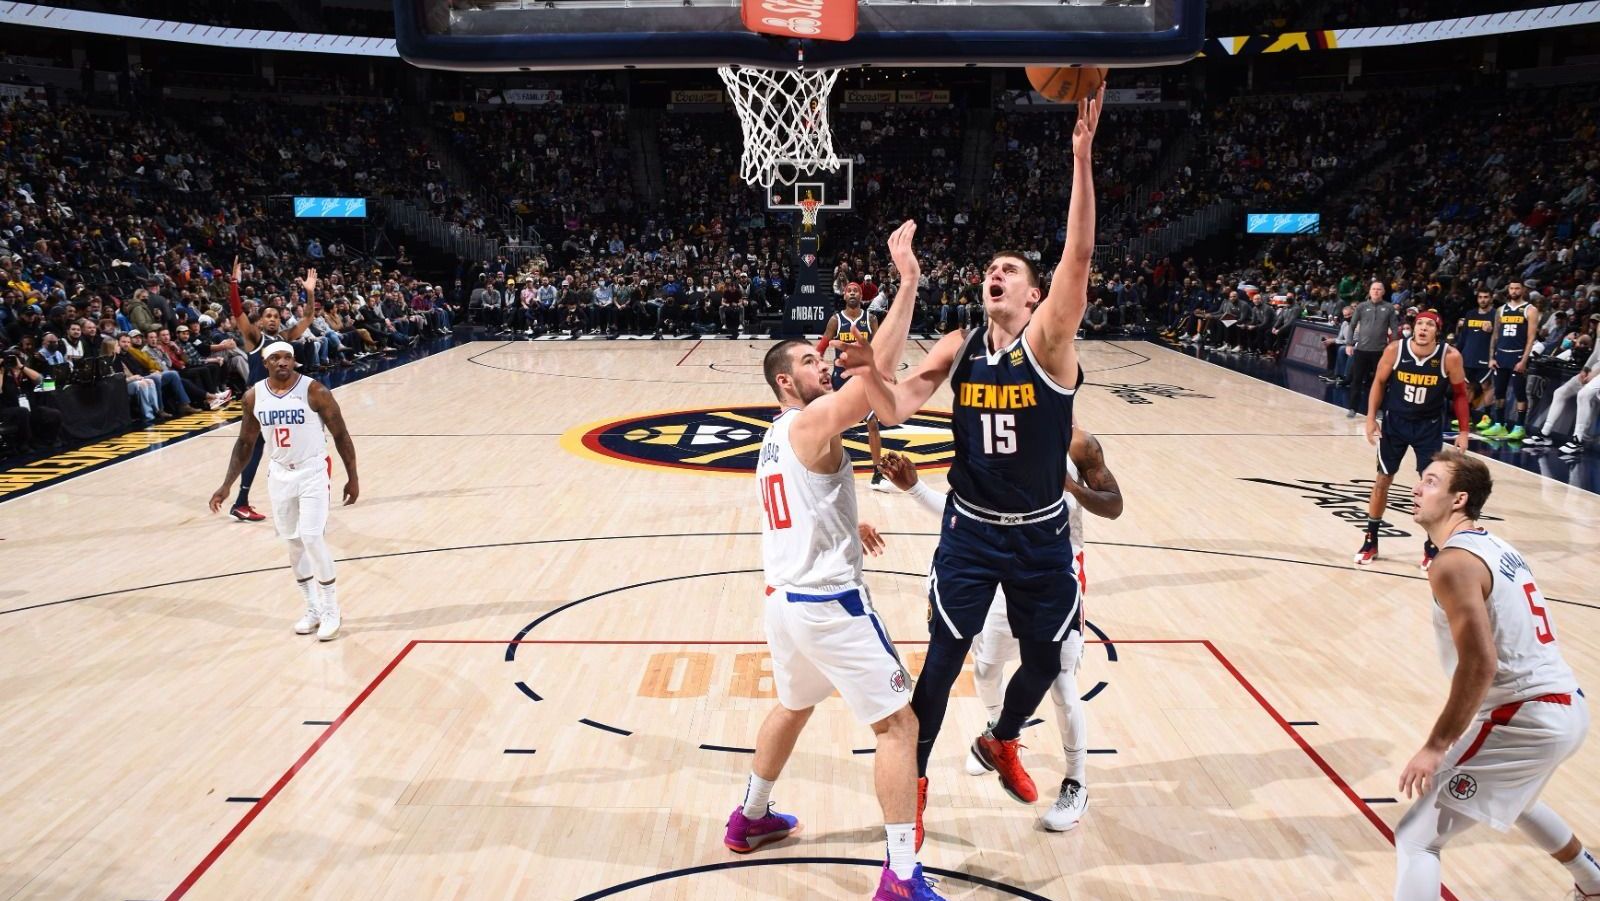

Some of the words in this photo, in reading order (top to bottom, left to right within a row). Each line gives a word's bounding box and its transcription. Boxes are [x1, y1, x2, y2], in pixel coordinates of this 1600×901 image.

[791, 306, 824, 321] #NBA75
[1503, 324, 1517, 336] 25
[1397, 370, 1438, 386] DENVER
[960, 382, 1037, 409] DENVER
[1403, 384, 1427, 405] 50
[258, 408, 305, 426] CLIPPERS
[275, 428, 291, 448] 12
[980, 413, 1017, 454] 15
[1523, 583, 1555, 645] 5
